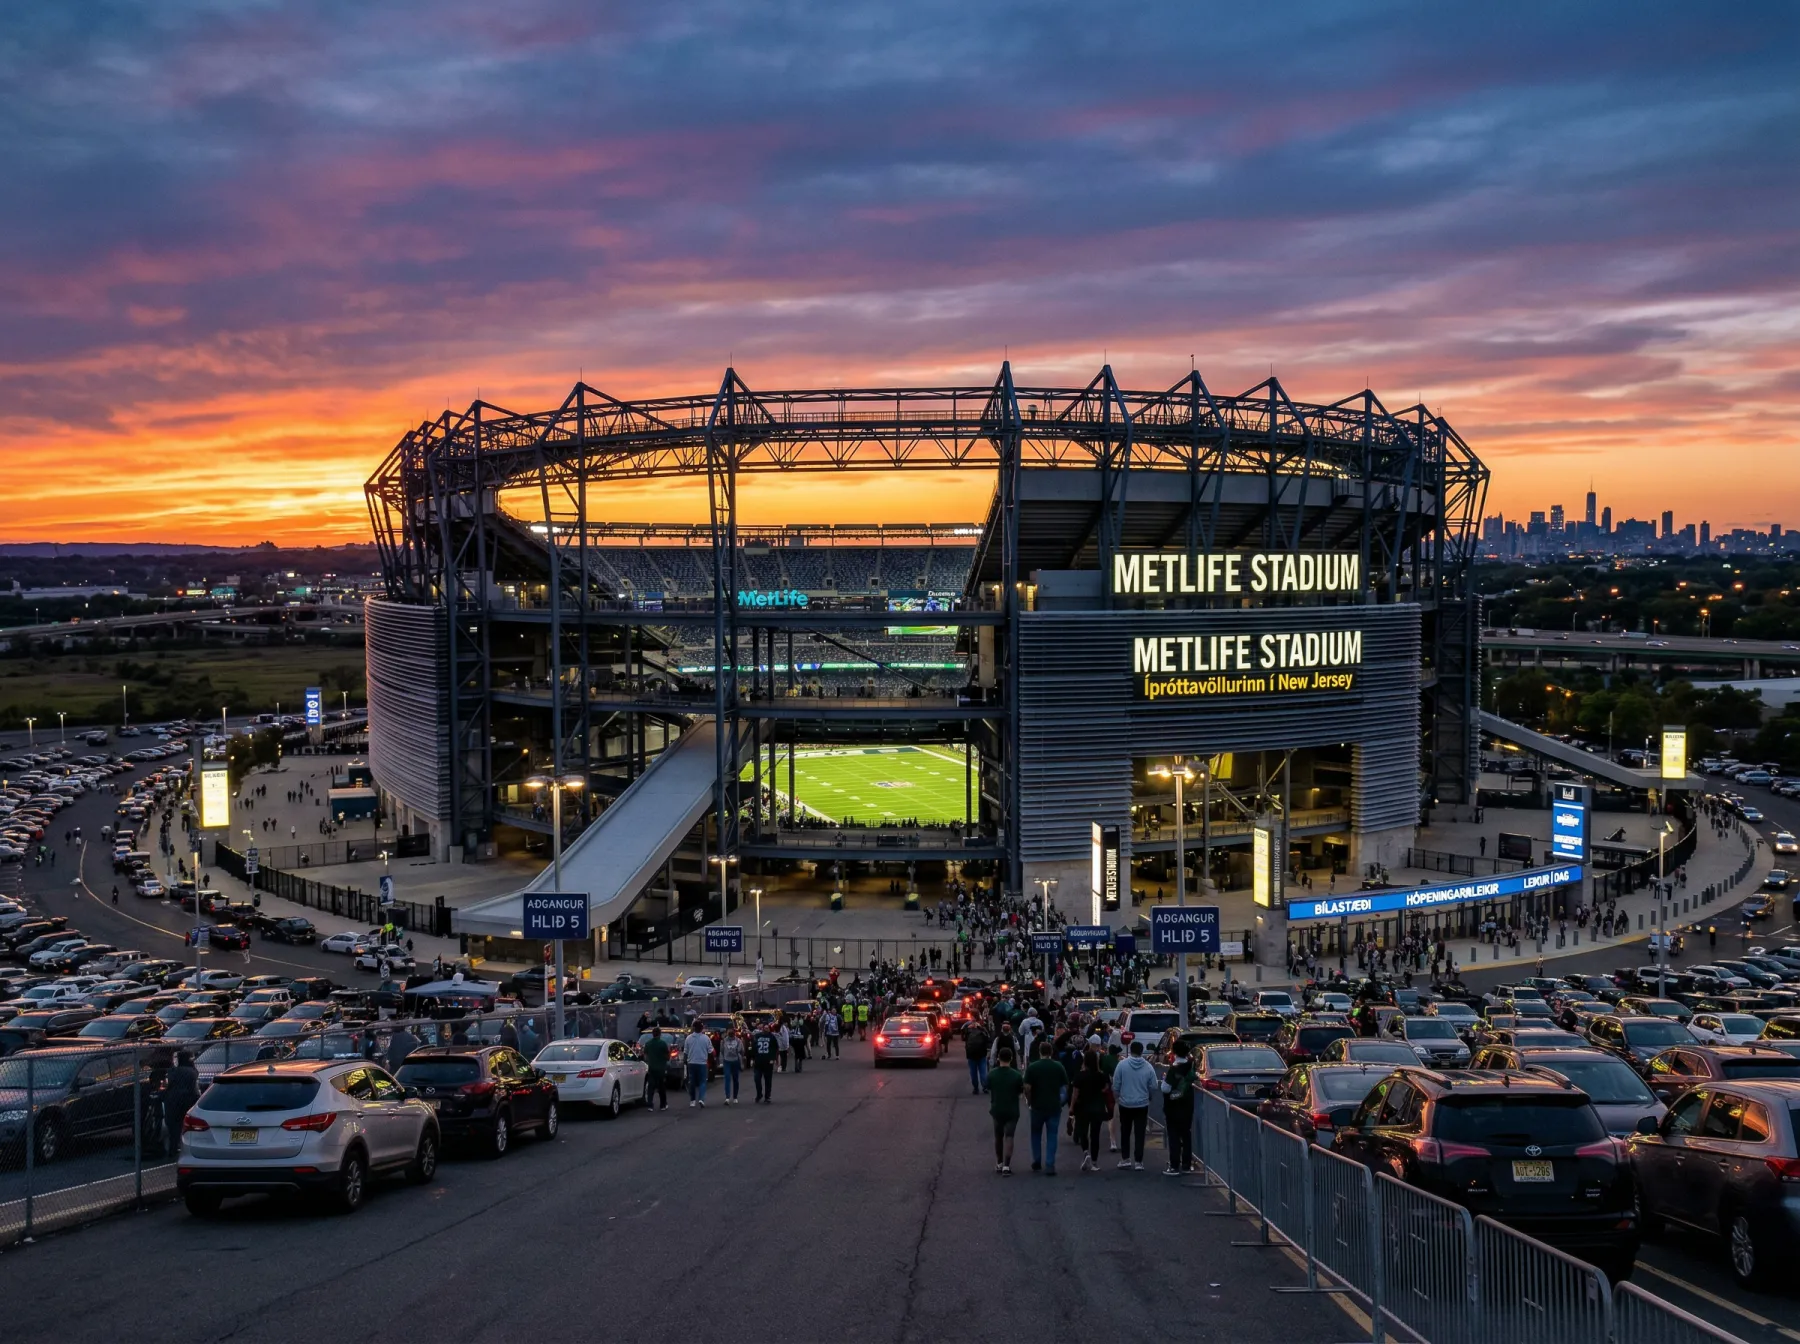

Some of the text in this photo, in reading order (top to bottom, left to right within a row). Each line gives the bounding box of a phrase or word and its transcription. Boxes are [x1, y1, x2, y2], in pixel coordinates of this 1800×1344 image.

[1114, 553, 1359, 593] METLIFE STADIUM
[1134, 630, 1362, 673] METLIFE STADIUM
[1278, 673, 1309, 690] New
[1311, 671, 1353, 690] Jersey
[527, 899, 584, 909] AÐGANGUR
[1314, 899, 1372, 915] BÍLASTÆÐI
[532, 915, 580, 928] HLIÐ 5
[1156, 913, 1215, 923] AÐGANGUR
[731, 938, 737, 947] 5
[1161, 929, 1210, 943] HLIÐ 5
